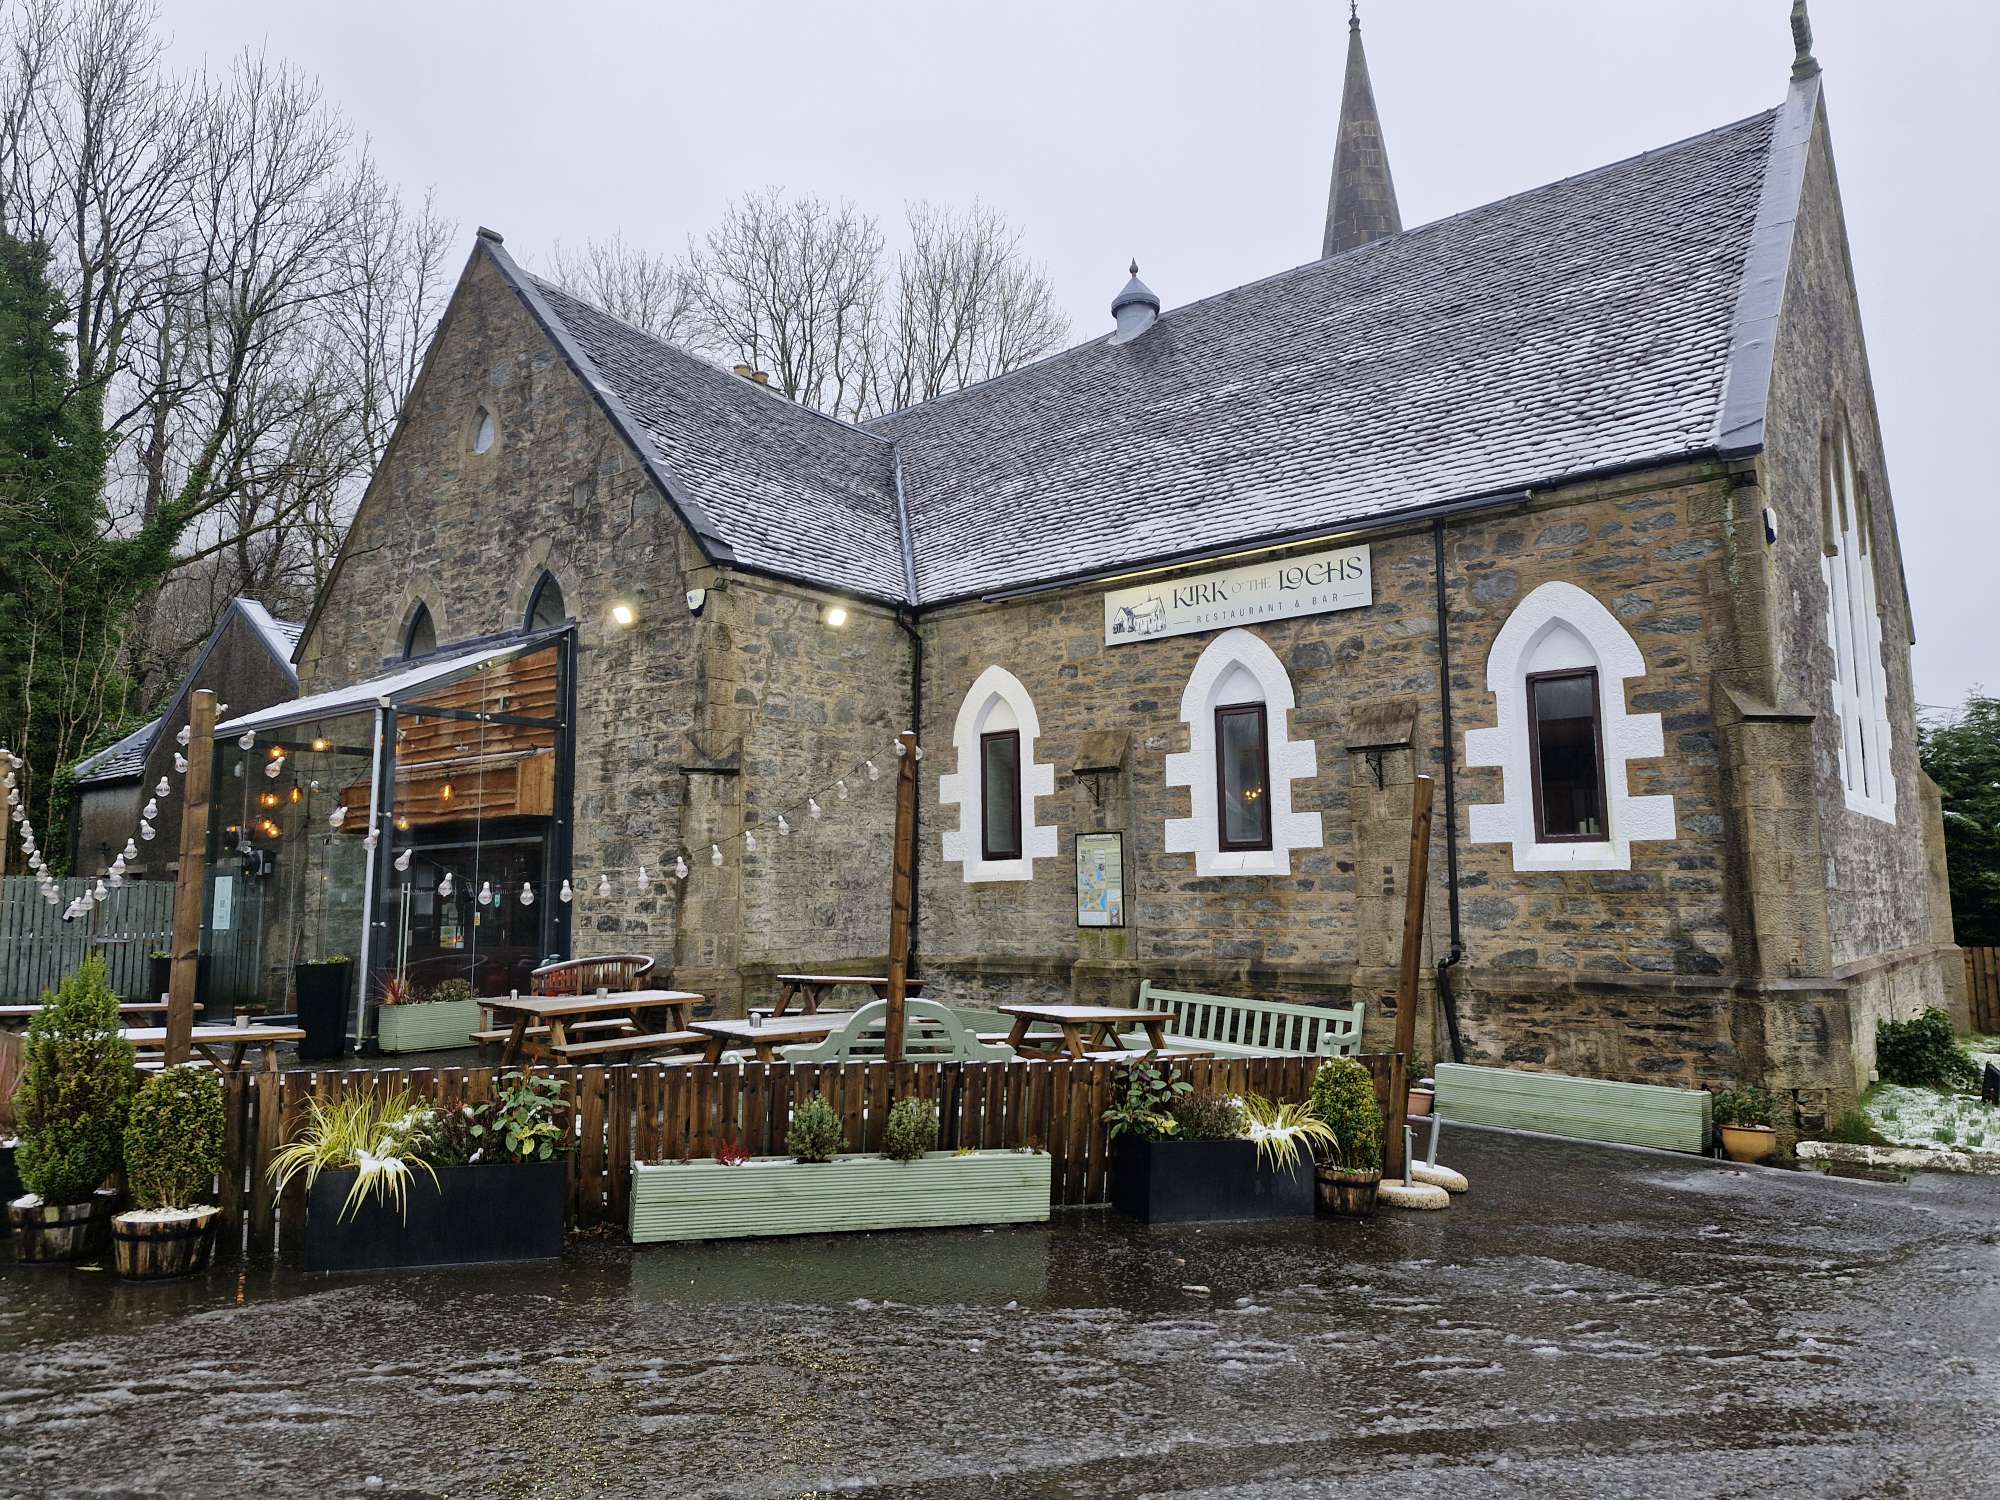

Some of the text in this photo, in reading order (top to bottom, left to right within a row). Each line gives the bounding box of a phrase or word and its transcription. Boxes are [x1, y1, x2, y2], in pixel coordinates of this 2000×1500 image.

[1173, 579, 1228, 608] KIRK
[1247, 576, 1272, 592] THE
[1278, 556, 1363, 591] LOCHS
[1196, 593, 1339, 624] RESTAURANT & BAR
